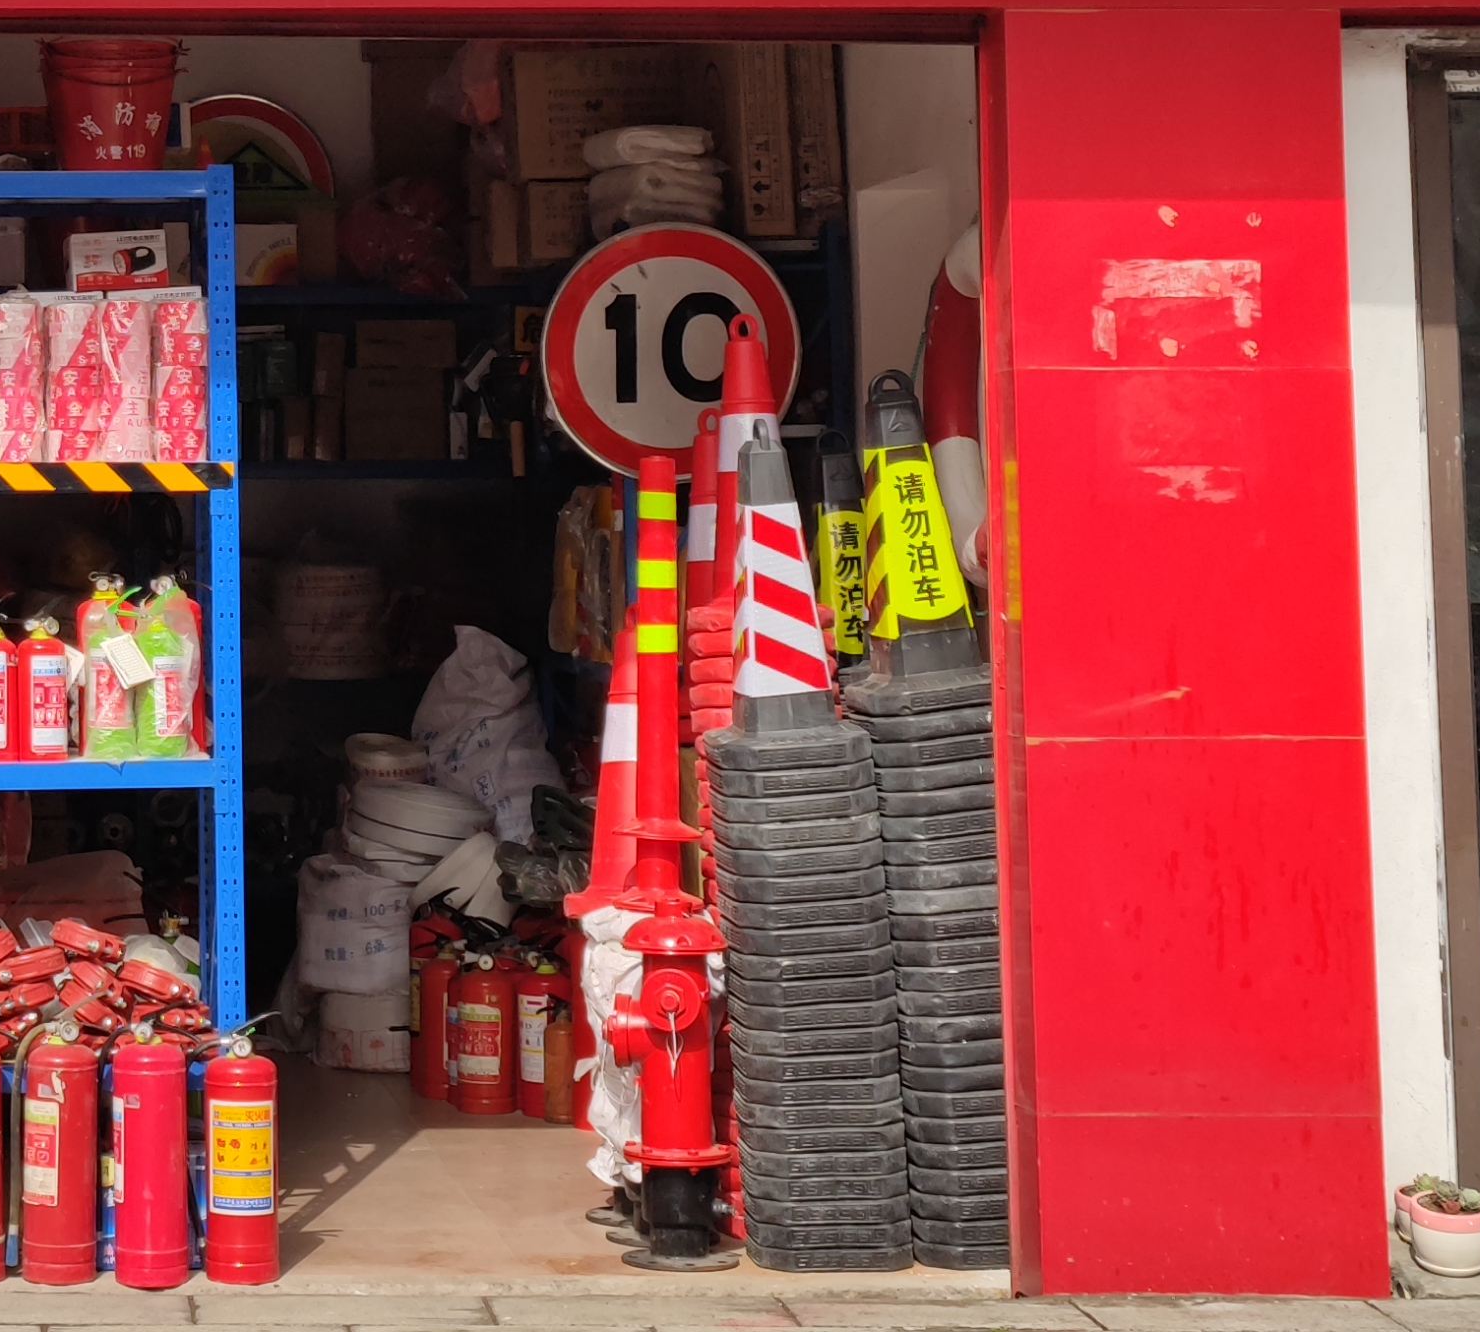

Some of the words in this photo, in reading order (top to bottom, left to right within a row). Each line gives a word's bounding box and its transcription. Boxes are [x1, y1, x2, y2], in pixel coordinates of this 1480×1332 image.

[603, 291, 747, 404] 10
[830, 521, 864, 643] 请勿泊车
[895, 472, 945, 607] 请勿泊车
